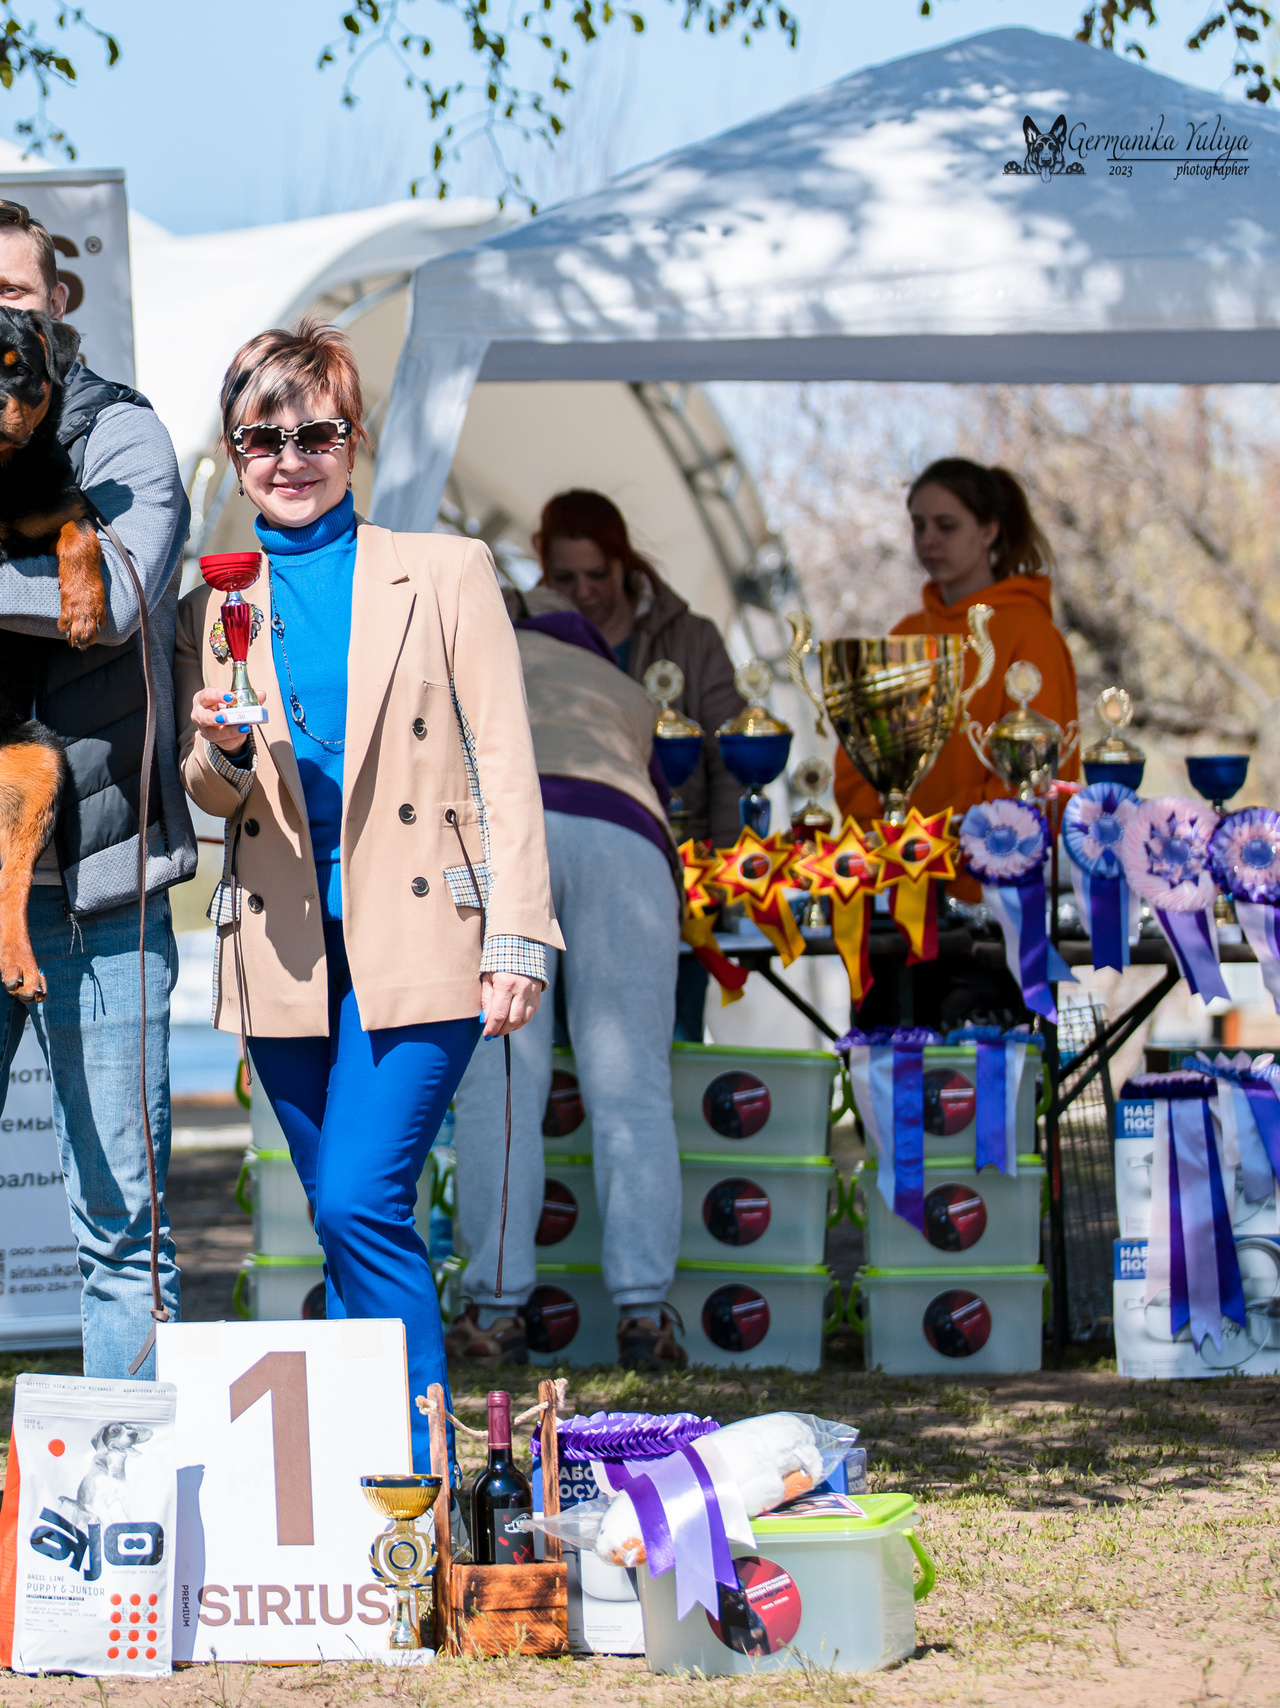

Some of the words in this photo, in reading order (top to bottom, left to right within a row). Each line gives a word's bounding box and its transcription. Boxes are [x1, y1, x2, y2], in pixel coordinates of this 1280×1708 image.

[1124, 1104, 1154, 1118] НАБ
[1124, 1117, 1154, 1131] ПОС
[1120, 1246, 1148, 1260] НАБ
[229, 1351, 314, 1545] 1
[558, 1466, 596, 1481] АБО
[559, 1484, 599, 1499] ОСУ
[26, 1582, 57, 1593] PUPPY
[60, 1584, 66, 1594] &
[69, 1585, 105, 1596] JUNIOR
[181, 1584, 190, 1627] PREMIUM
[197, 1583, 391, 1627] SIRIUS
